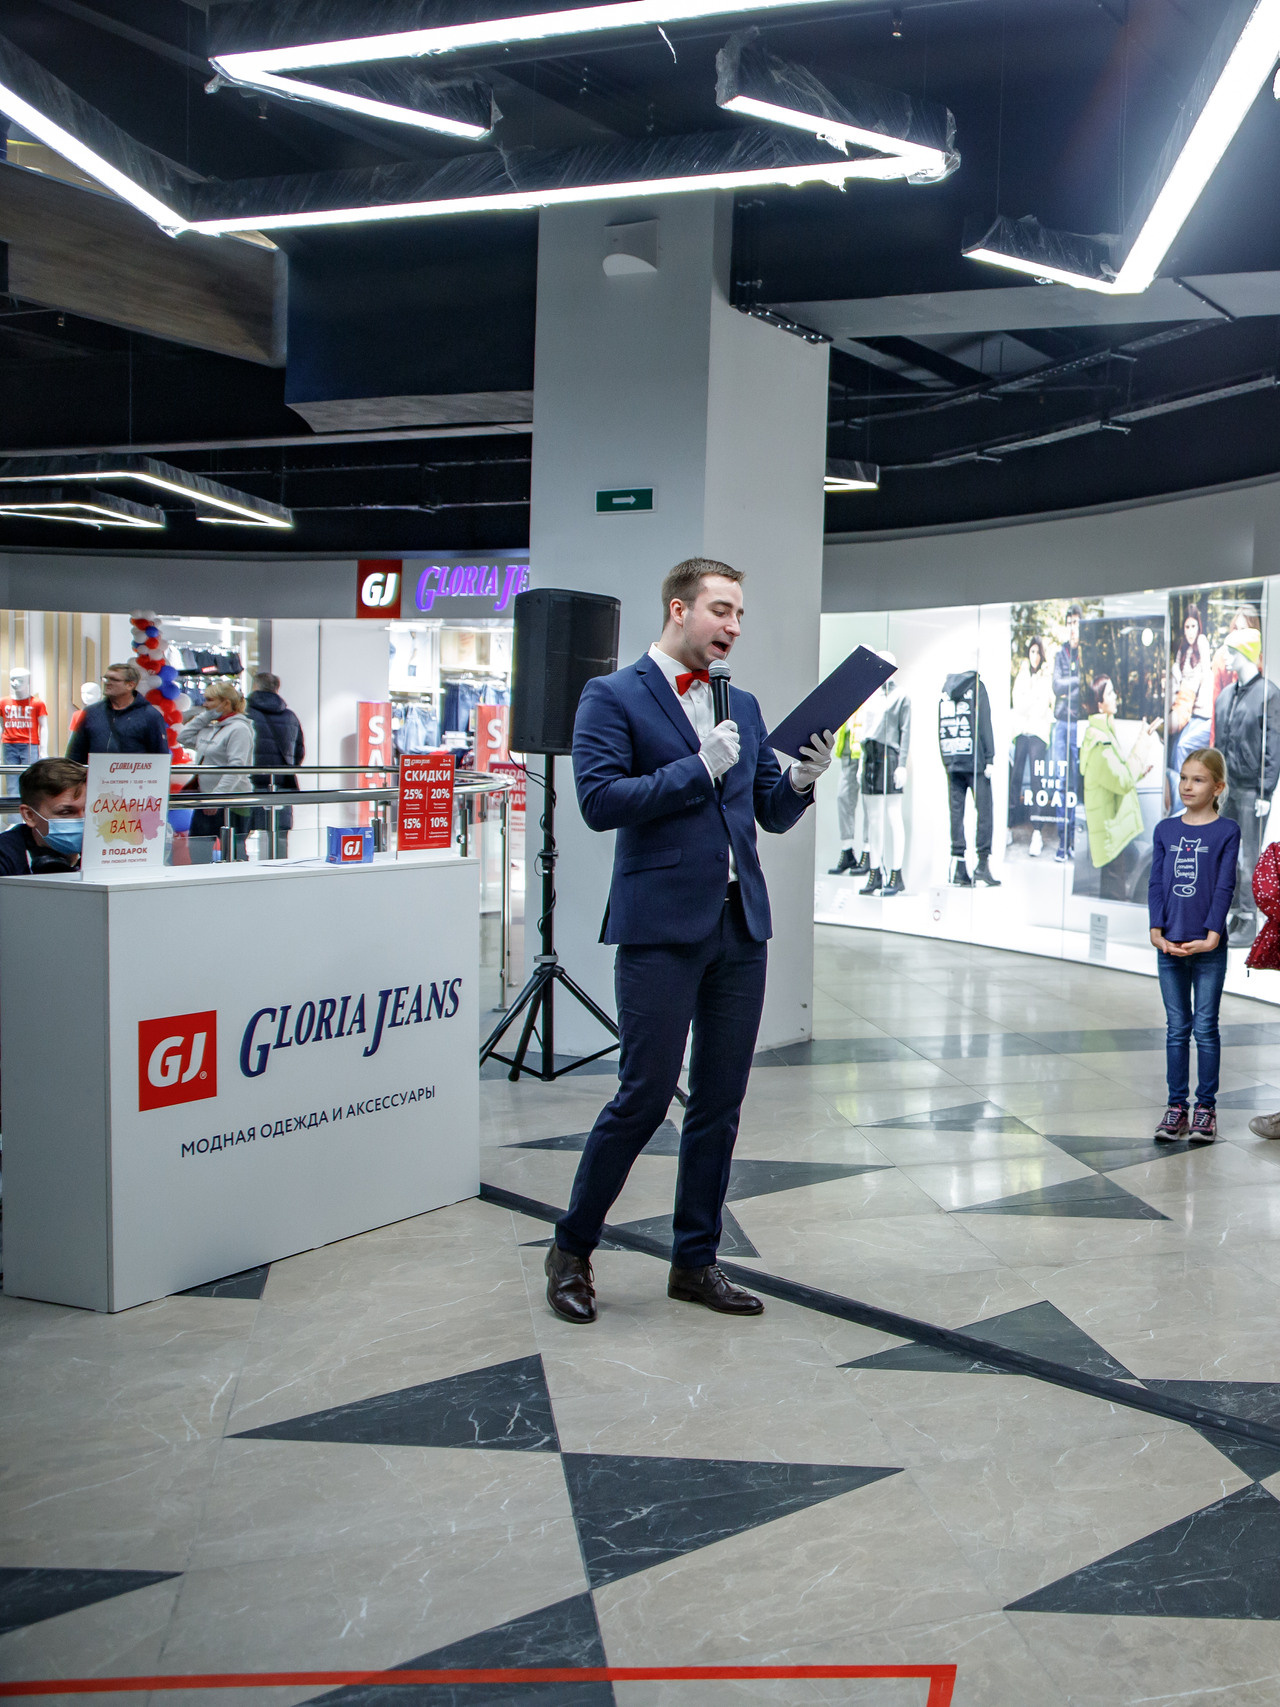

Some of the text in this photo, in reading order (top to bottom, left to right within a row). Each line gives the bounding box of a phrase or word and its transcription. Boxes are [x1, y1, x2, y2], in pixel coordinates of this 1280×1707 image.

[361, 572, 399, 607] GJ
[415, 565, 530, 612] GLORIA JE
[4, 705, 33, 719] SALE
[109, 762, 152, 773] GLORIA JEANS
[1034, 760, 1068, 777] HIT
[404, 770, 451, 782] СКИДКИ
[1041, 778, 1061, 789] THE
[403, 788, 450, 800] 25% 20%
[1024, 789, 1077, 808] ROAD
[93, 798, 162, 813] САХАРНАЯ
[110, 819, 143, 834] ВАТА
[403, 816, 448, 829] 15% 10%
[108, 847, 148, 856] ПОДАРОК
[344, 841, 360, 856] GJ
[239, 978, 462, 1078] GLORIA JEANS
[180, 1085, 436, 1158] МОДНАЯ ОДЕЖДА И АКСЕССУАРЫ
